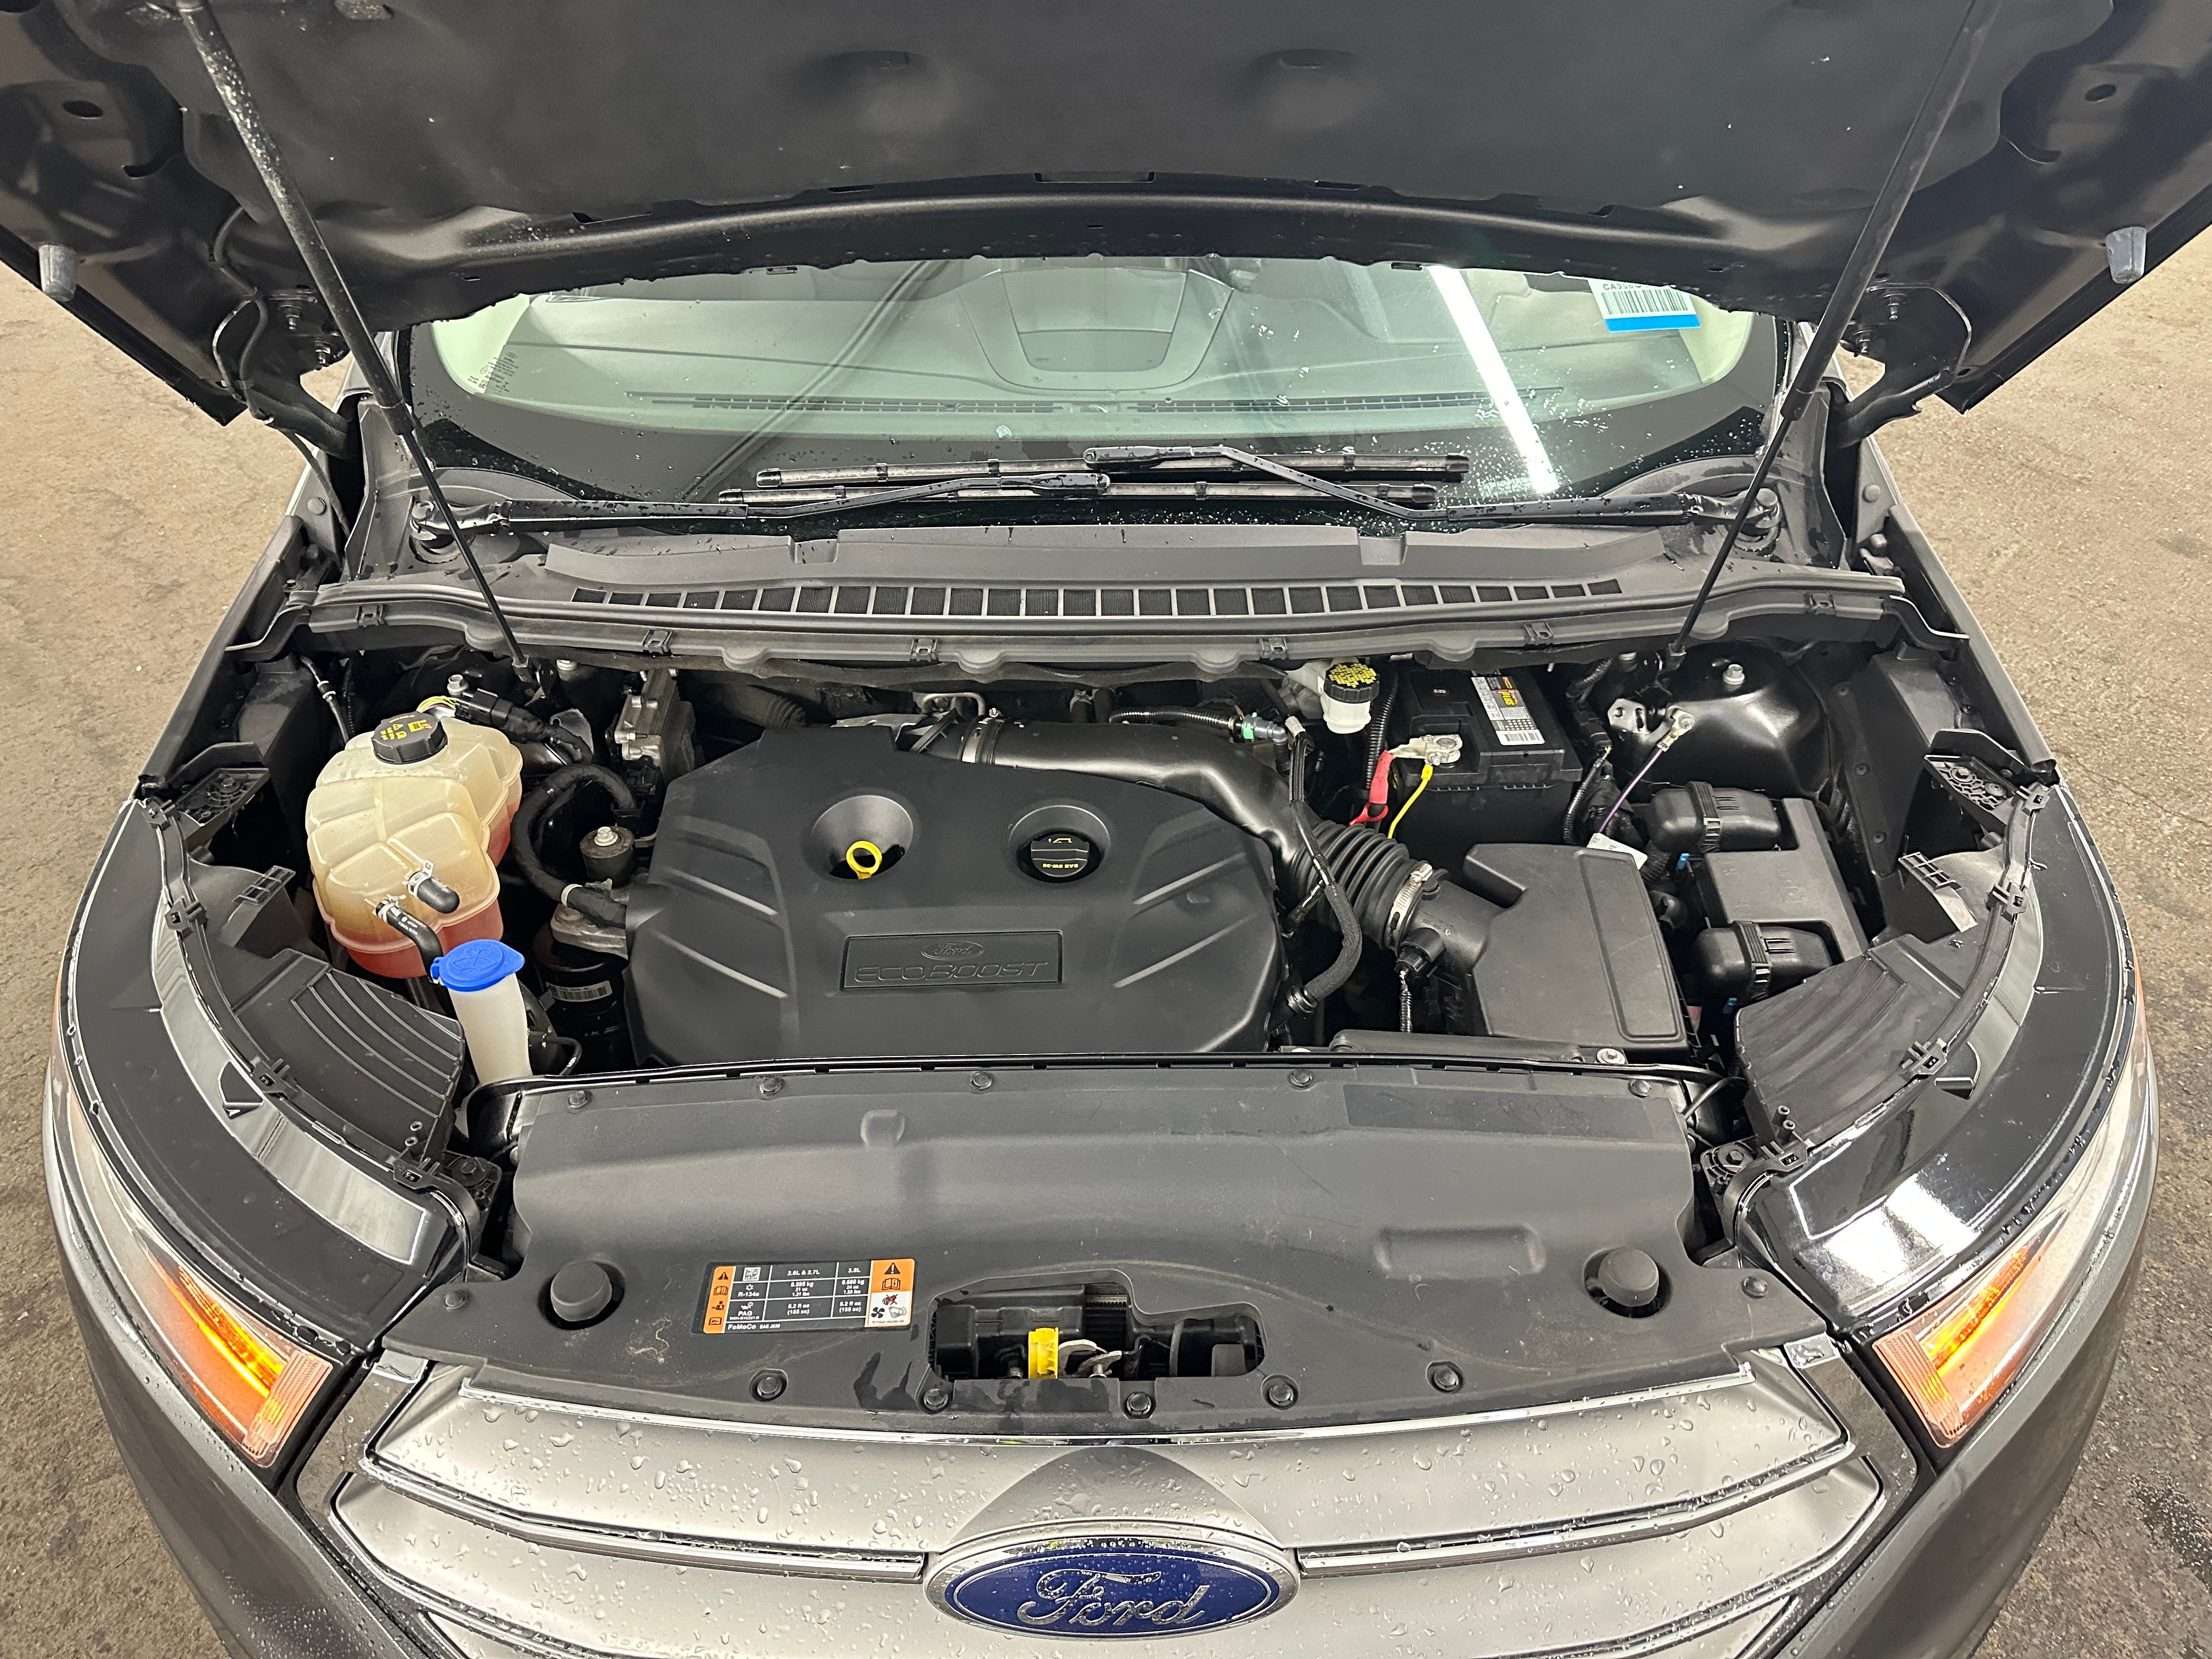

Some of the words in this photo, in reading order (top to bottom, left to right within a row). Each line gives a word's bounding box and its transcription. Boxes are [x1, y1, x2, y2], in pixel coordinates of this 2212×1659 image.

[934, 943, 974, 956] Ford
[854, 962, 1048, 983] ECOBOOST
[1015, 1568, 1210, 1626] Ford
